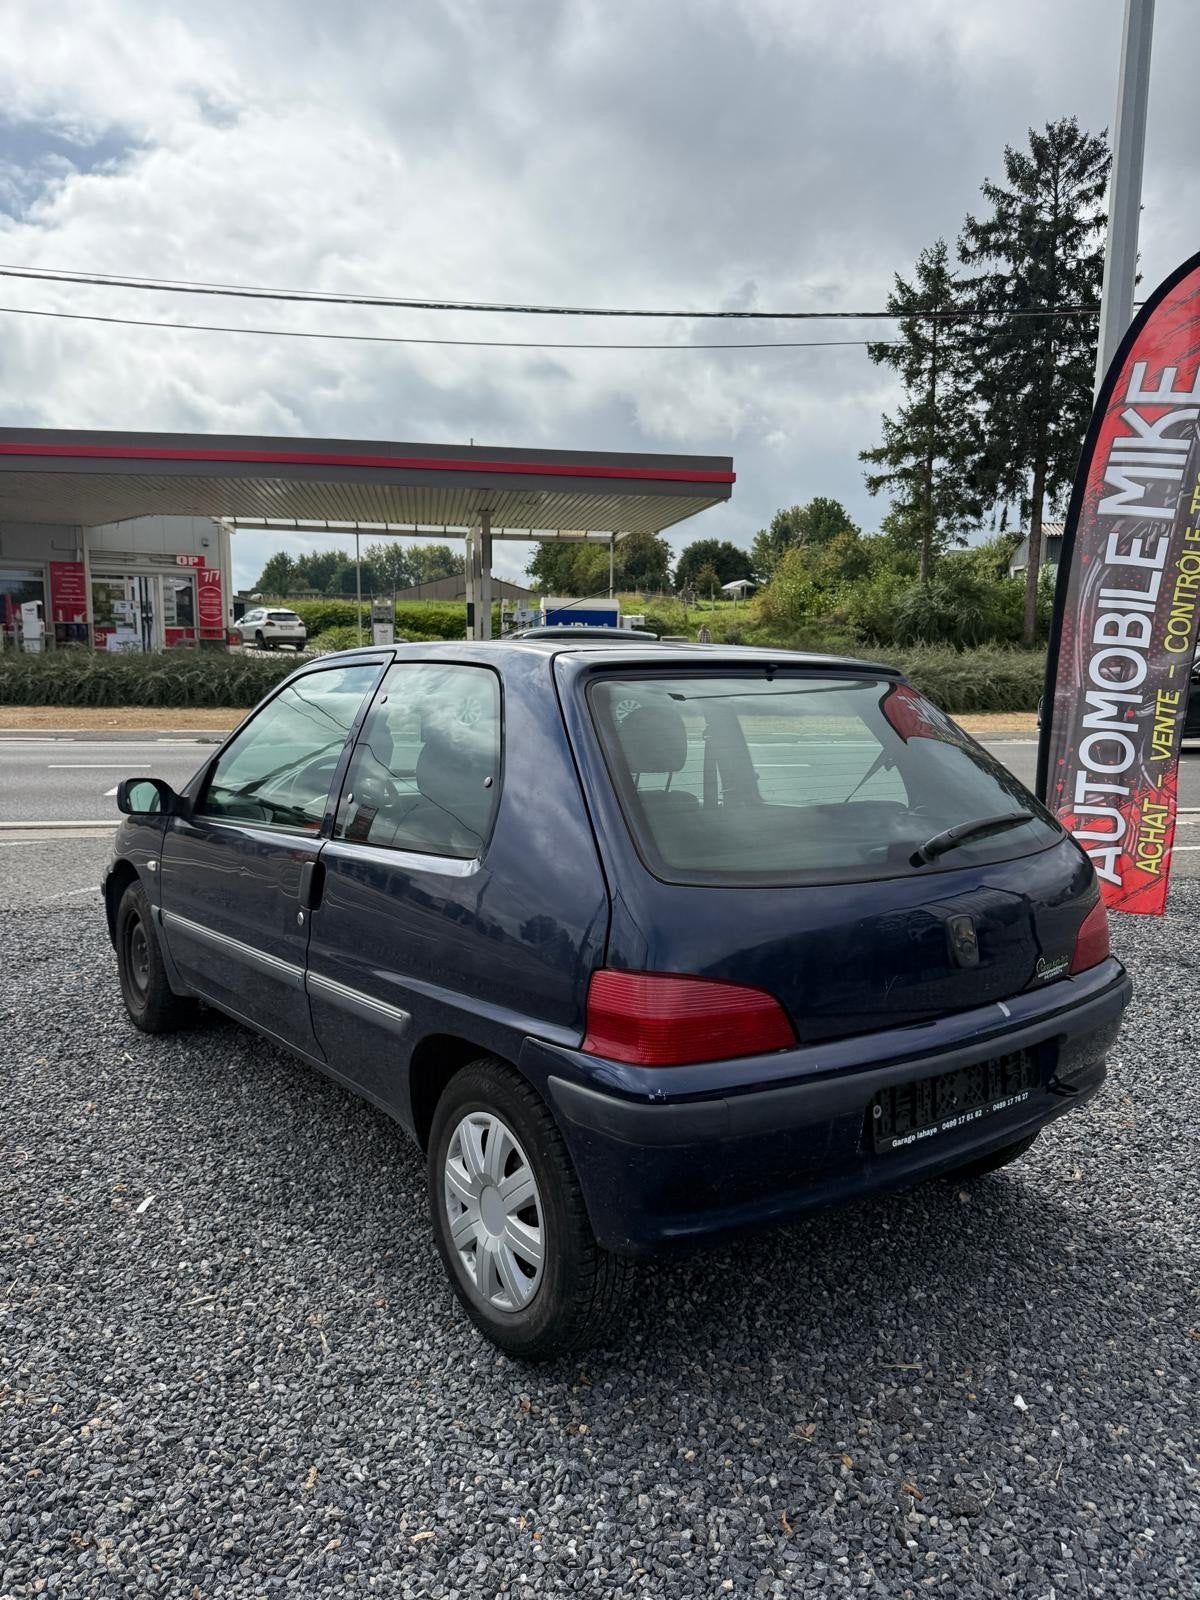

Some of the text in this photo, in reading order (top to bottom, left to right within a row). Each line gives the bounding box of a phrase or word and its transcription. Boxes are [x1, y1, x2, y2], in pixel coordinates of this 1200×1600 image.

[1072, 361, 1200, 886] AUTOMOBILE MIKE
[1150, 688, 1180, 761] VENTE
[1136, 798, 1169, 875] ACHAT
[892, 1135, 916, 1147] Garage
